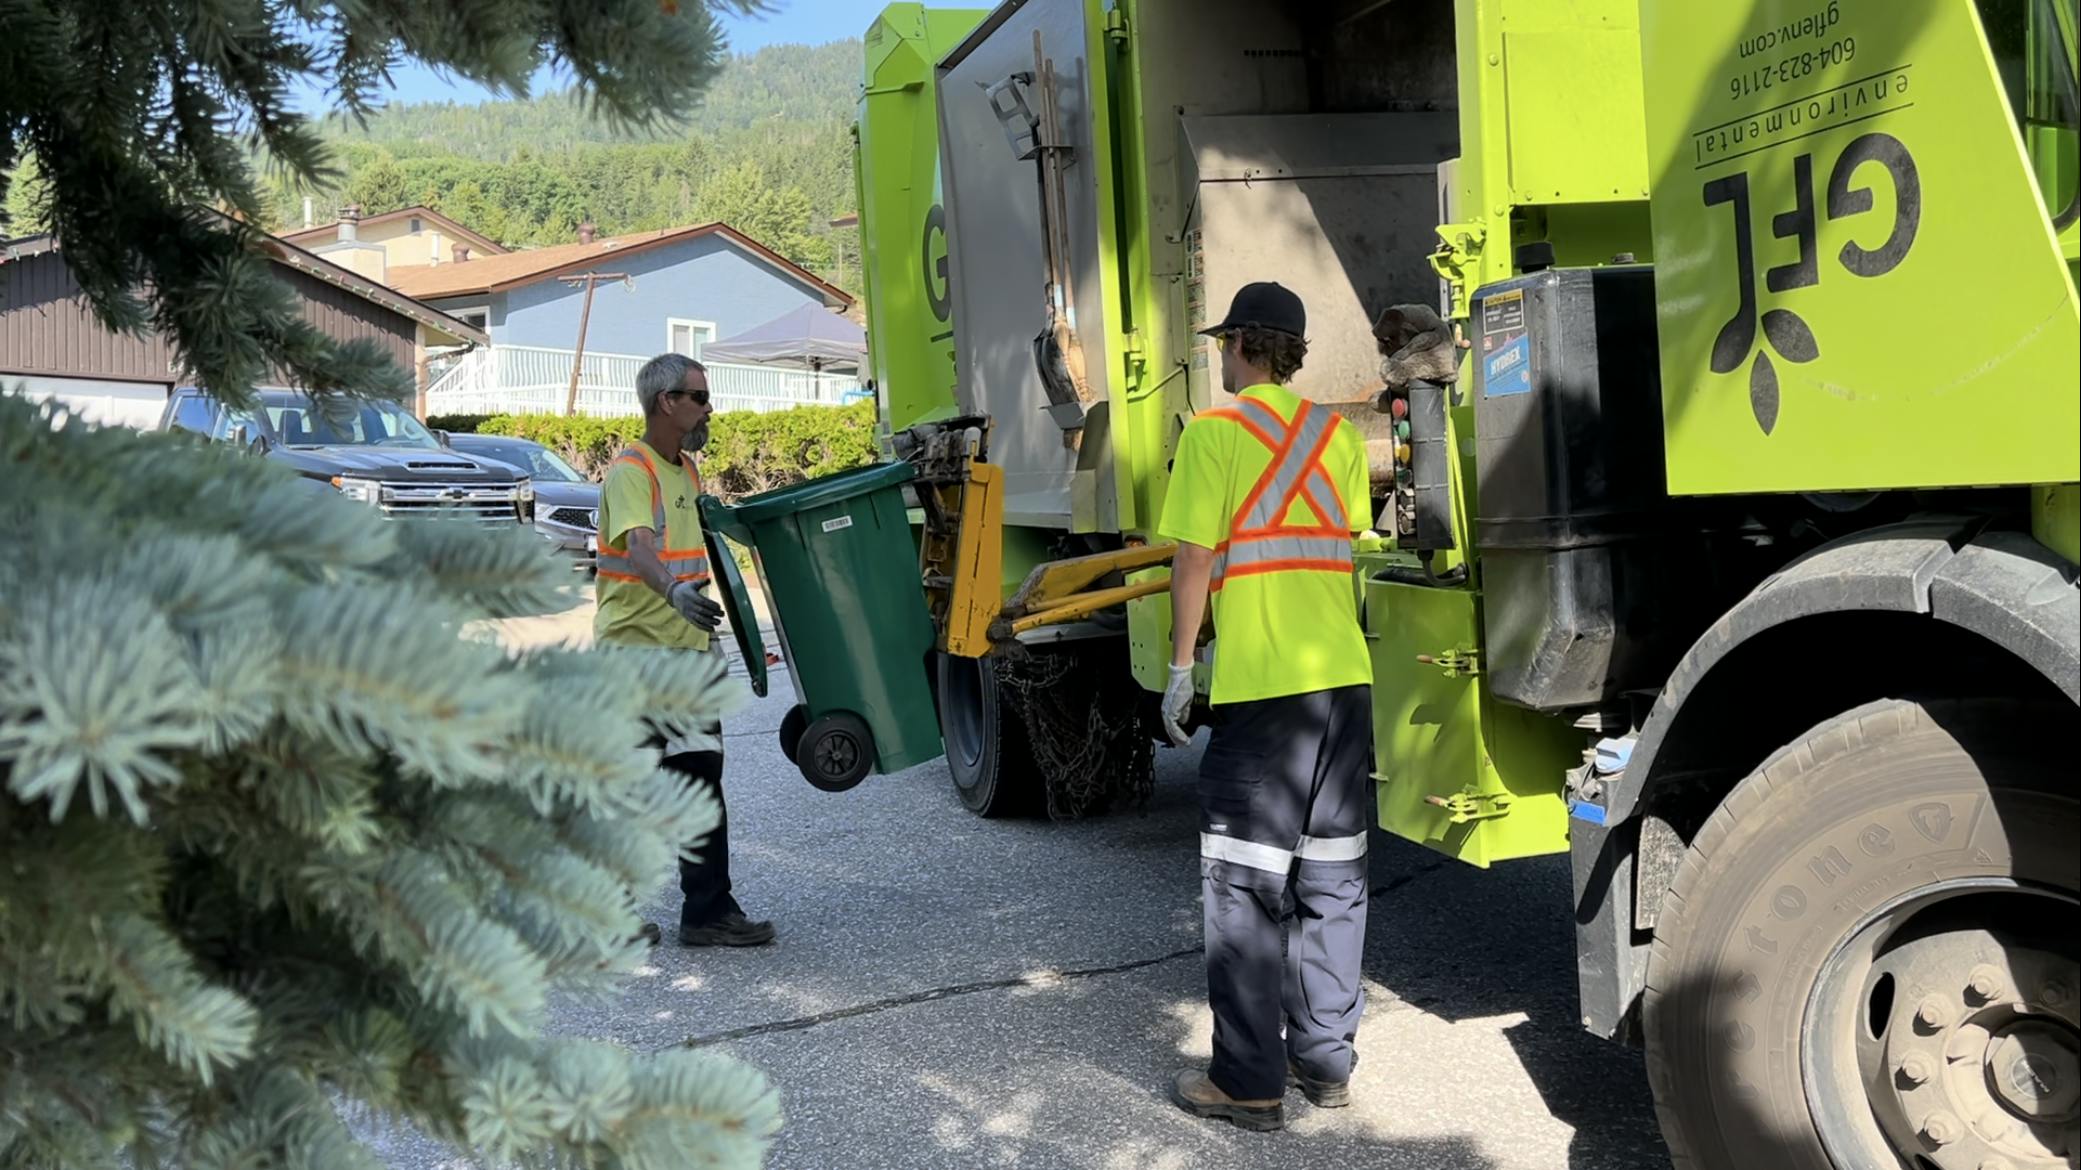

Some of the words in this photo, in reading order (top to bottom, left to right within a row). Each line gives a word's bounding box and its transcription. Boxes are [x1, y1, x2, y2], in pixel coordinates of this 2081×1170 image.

[1739, 1, 1840, 58] gflenv.com
[1730, 37, 1856, 100] 604-823-2116
[1696, 75, 1909, 161] environmental
[1703, 132, 1921, 374] GFL
